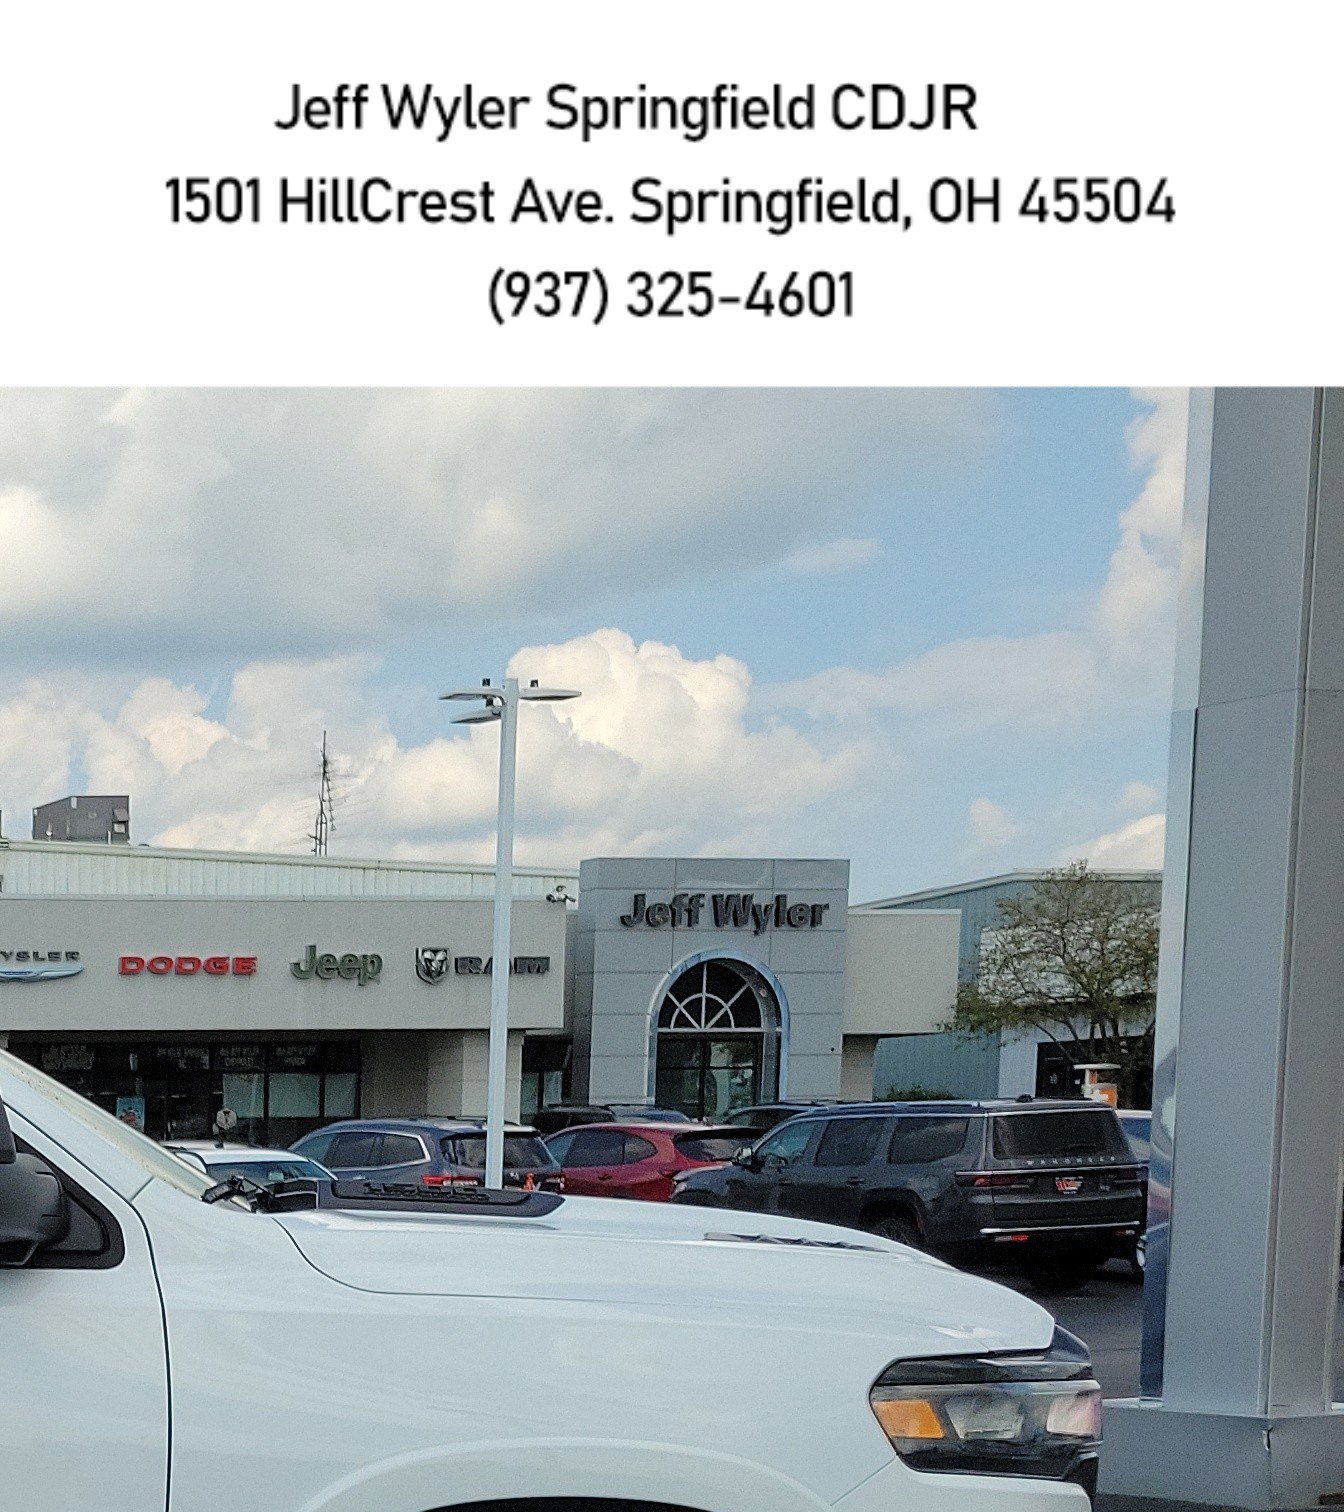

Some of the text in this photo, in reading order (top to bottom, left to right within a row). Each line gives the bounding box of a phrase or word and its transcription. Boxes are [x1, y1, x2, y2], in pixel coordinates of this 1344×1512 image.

[620, 893, 829, 936] Jeff Wyler
[118, 956, 258, 976] DODGE
[289, 945, 383, 986] Jeep
